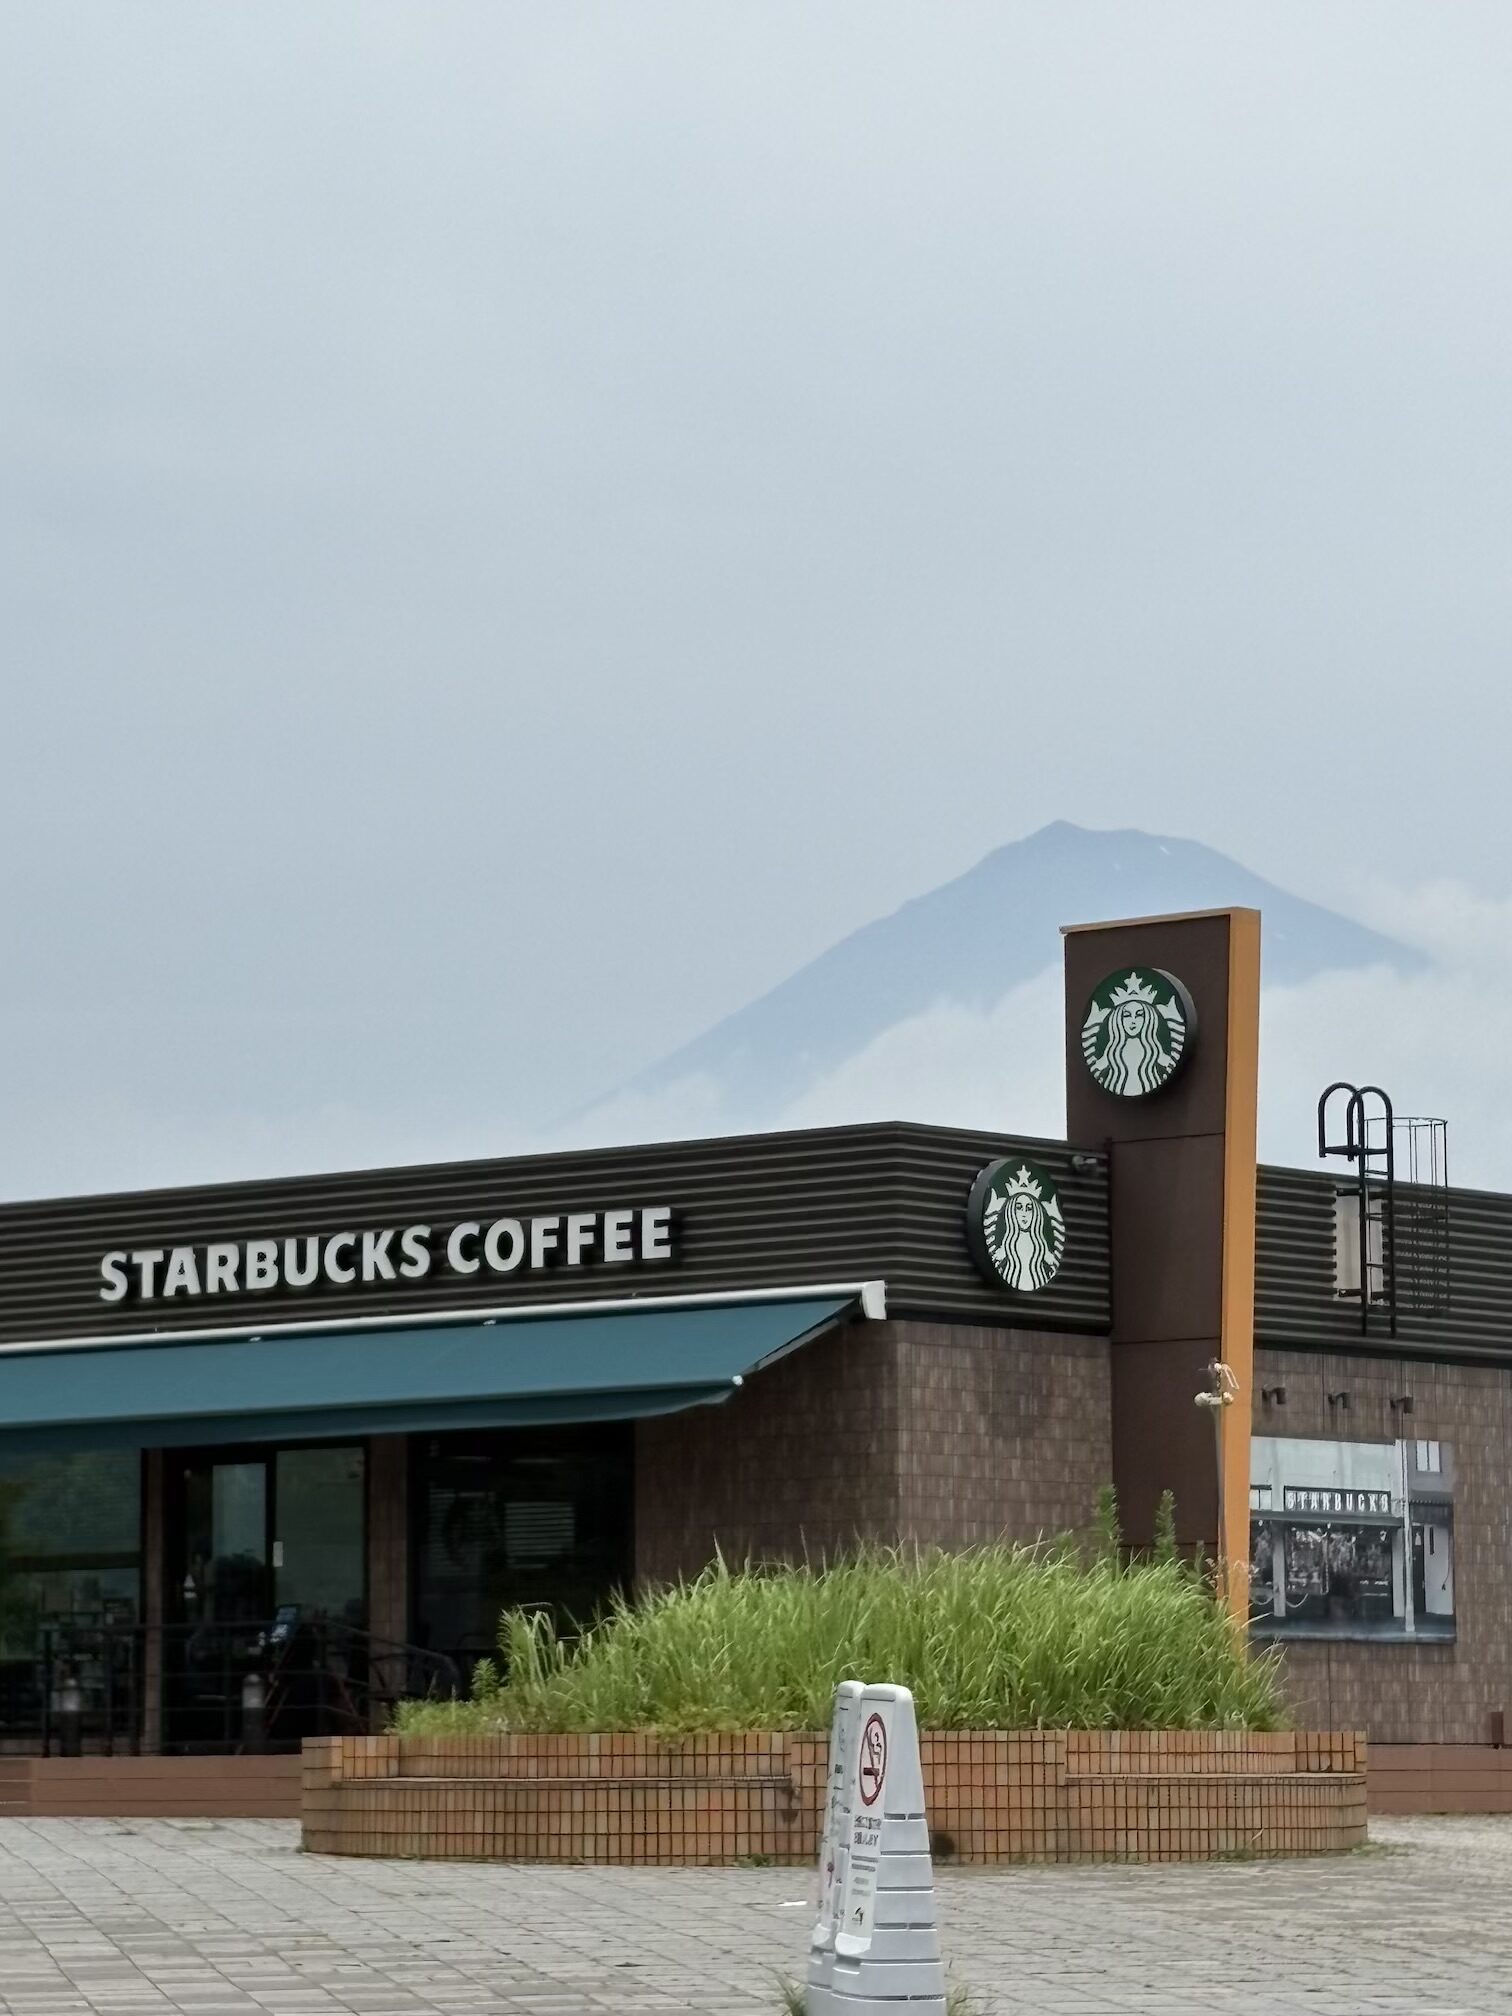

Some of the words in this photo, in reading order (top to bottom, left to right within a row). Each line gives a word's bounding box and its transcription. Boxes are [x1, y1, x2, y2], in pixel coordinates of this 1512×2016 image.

[99, 1225, 431, 1301] STARBUCKS
[448, 1207, 672, 1274] COFFEE
[1286, 1491, 1389, 1512] STARBUCKS
